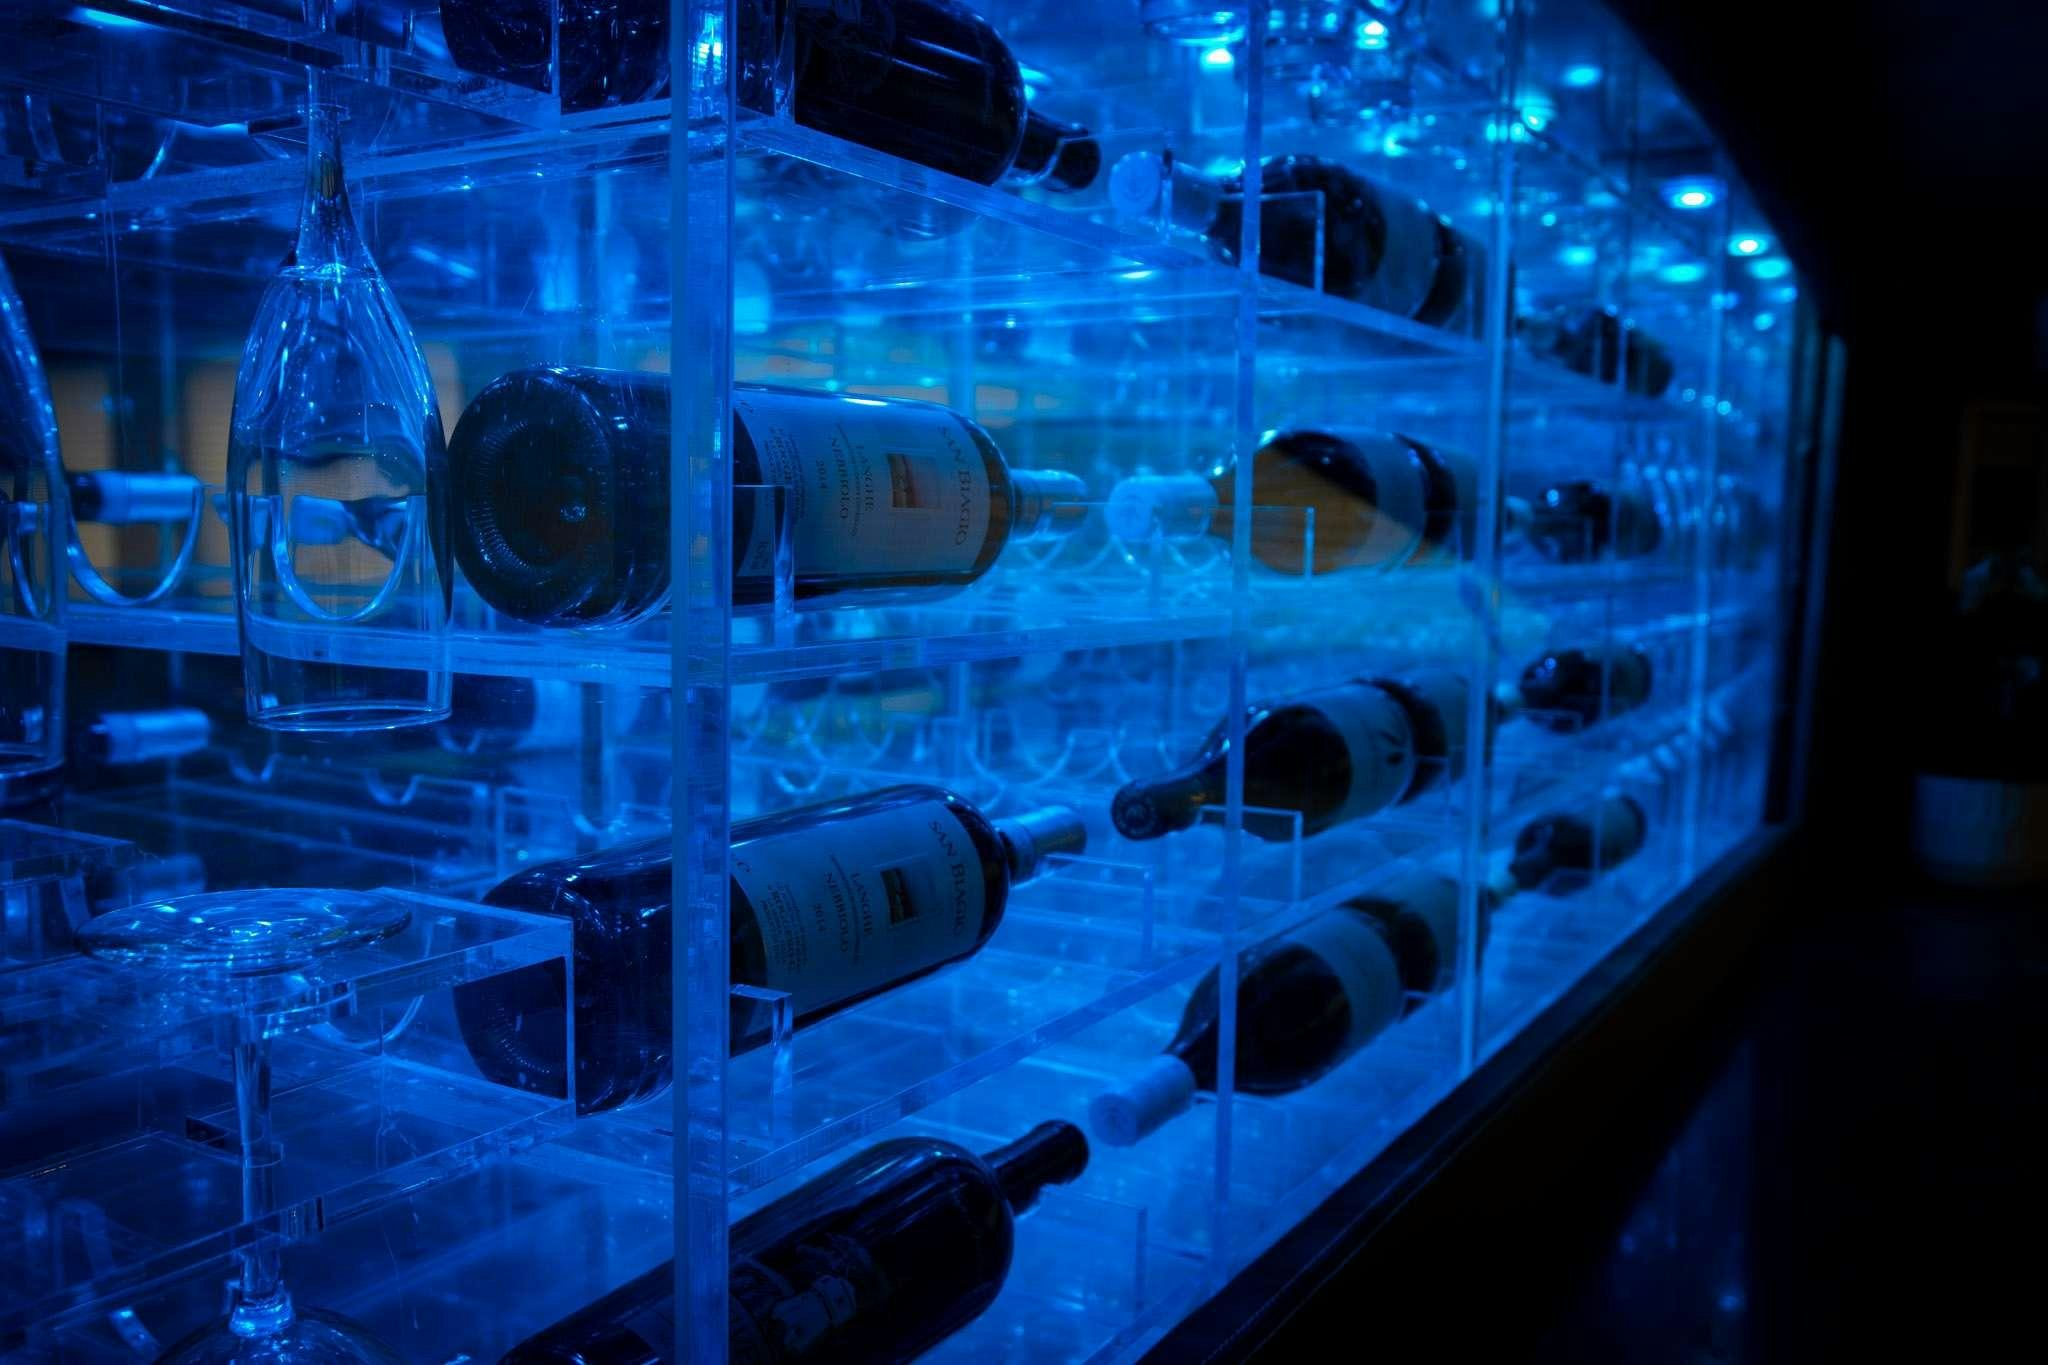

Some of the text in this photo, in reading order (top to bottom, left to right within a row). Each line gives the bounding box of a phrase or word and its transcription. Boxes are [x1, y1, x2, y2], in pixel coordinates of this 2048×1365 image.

[953, 470, 971, 546] BIAGIO
[928, 819, 968, 937] SAN BIAGIO
